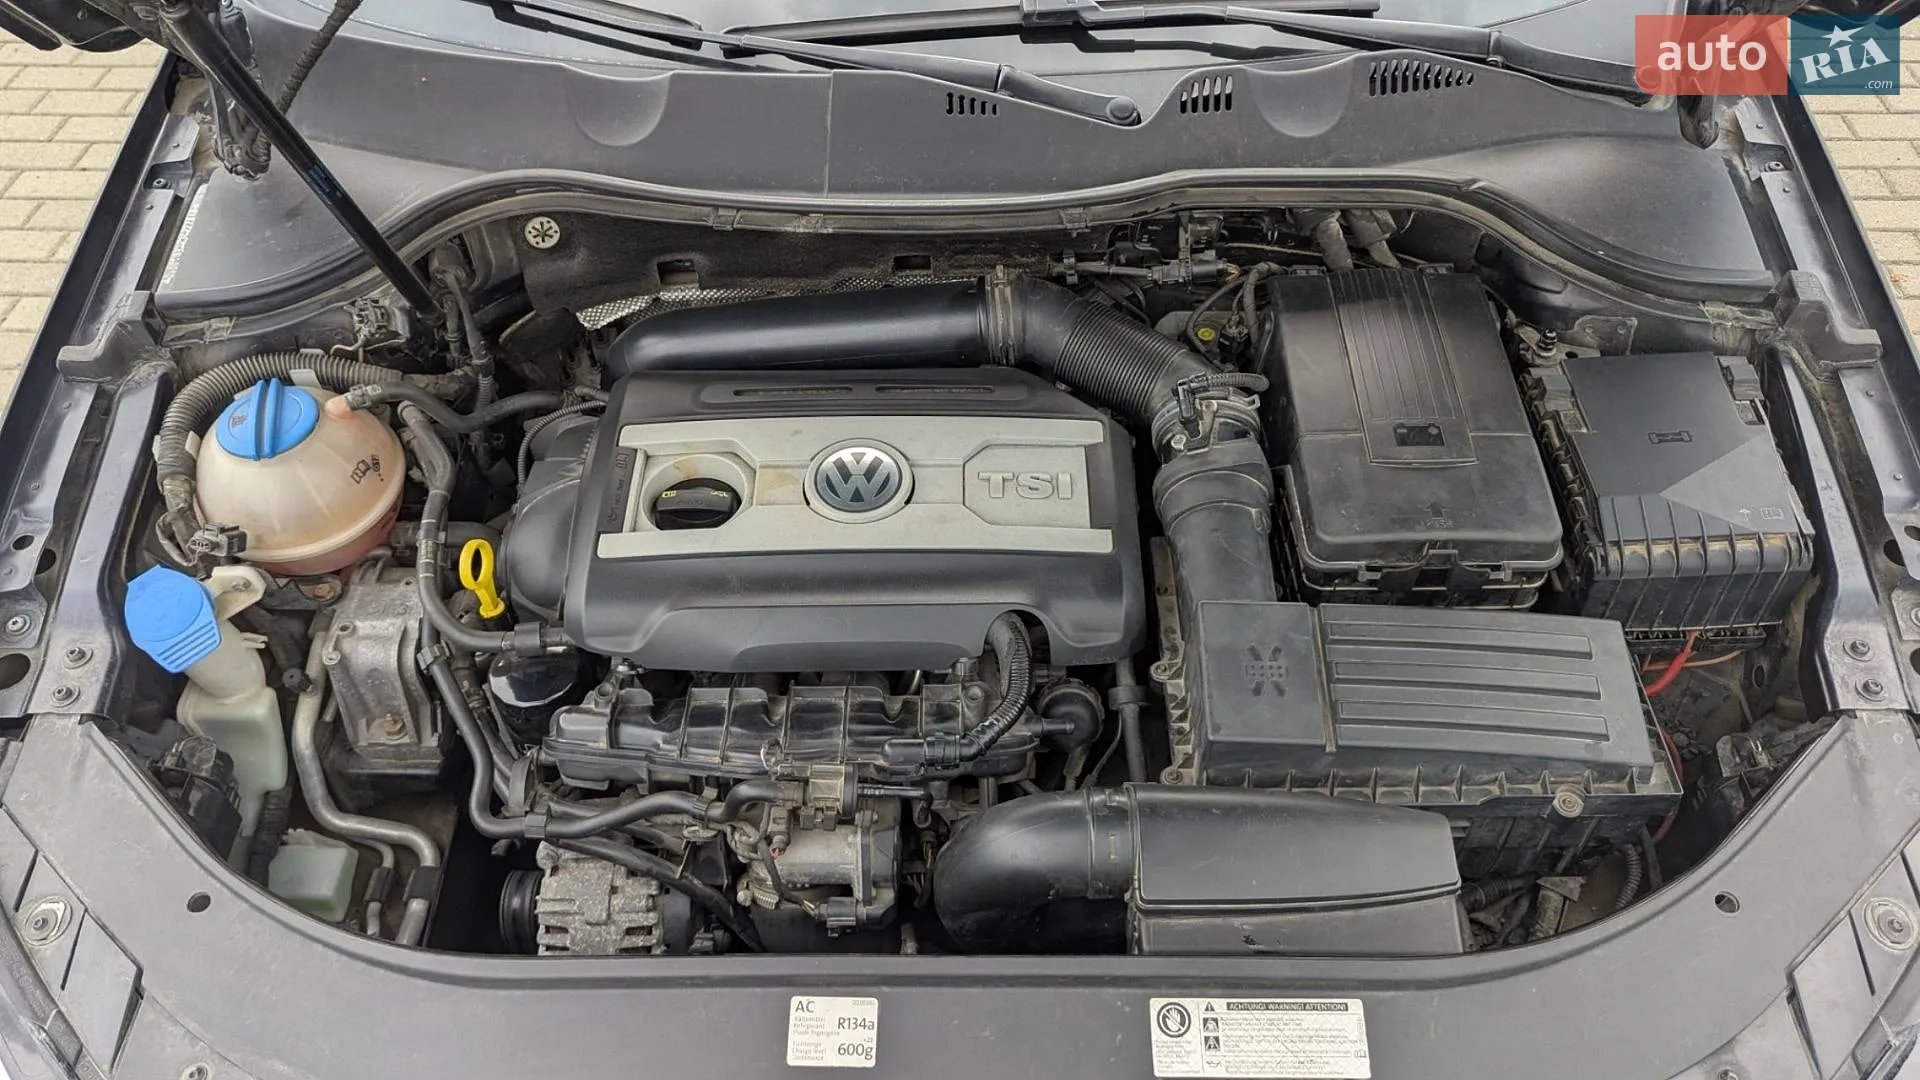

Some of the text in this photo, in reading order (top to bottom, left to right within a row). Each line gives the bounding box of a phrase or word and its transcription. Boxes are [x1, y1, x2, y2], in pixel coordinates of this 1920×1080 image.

[978, 471, 1073, 499] TSI
[795, 1000, 815, 1013] AC
[838, 1017, 875, 1030] R134a
[838, 1043, 874, 1061] 600g
